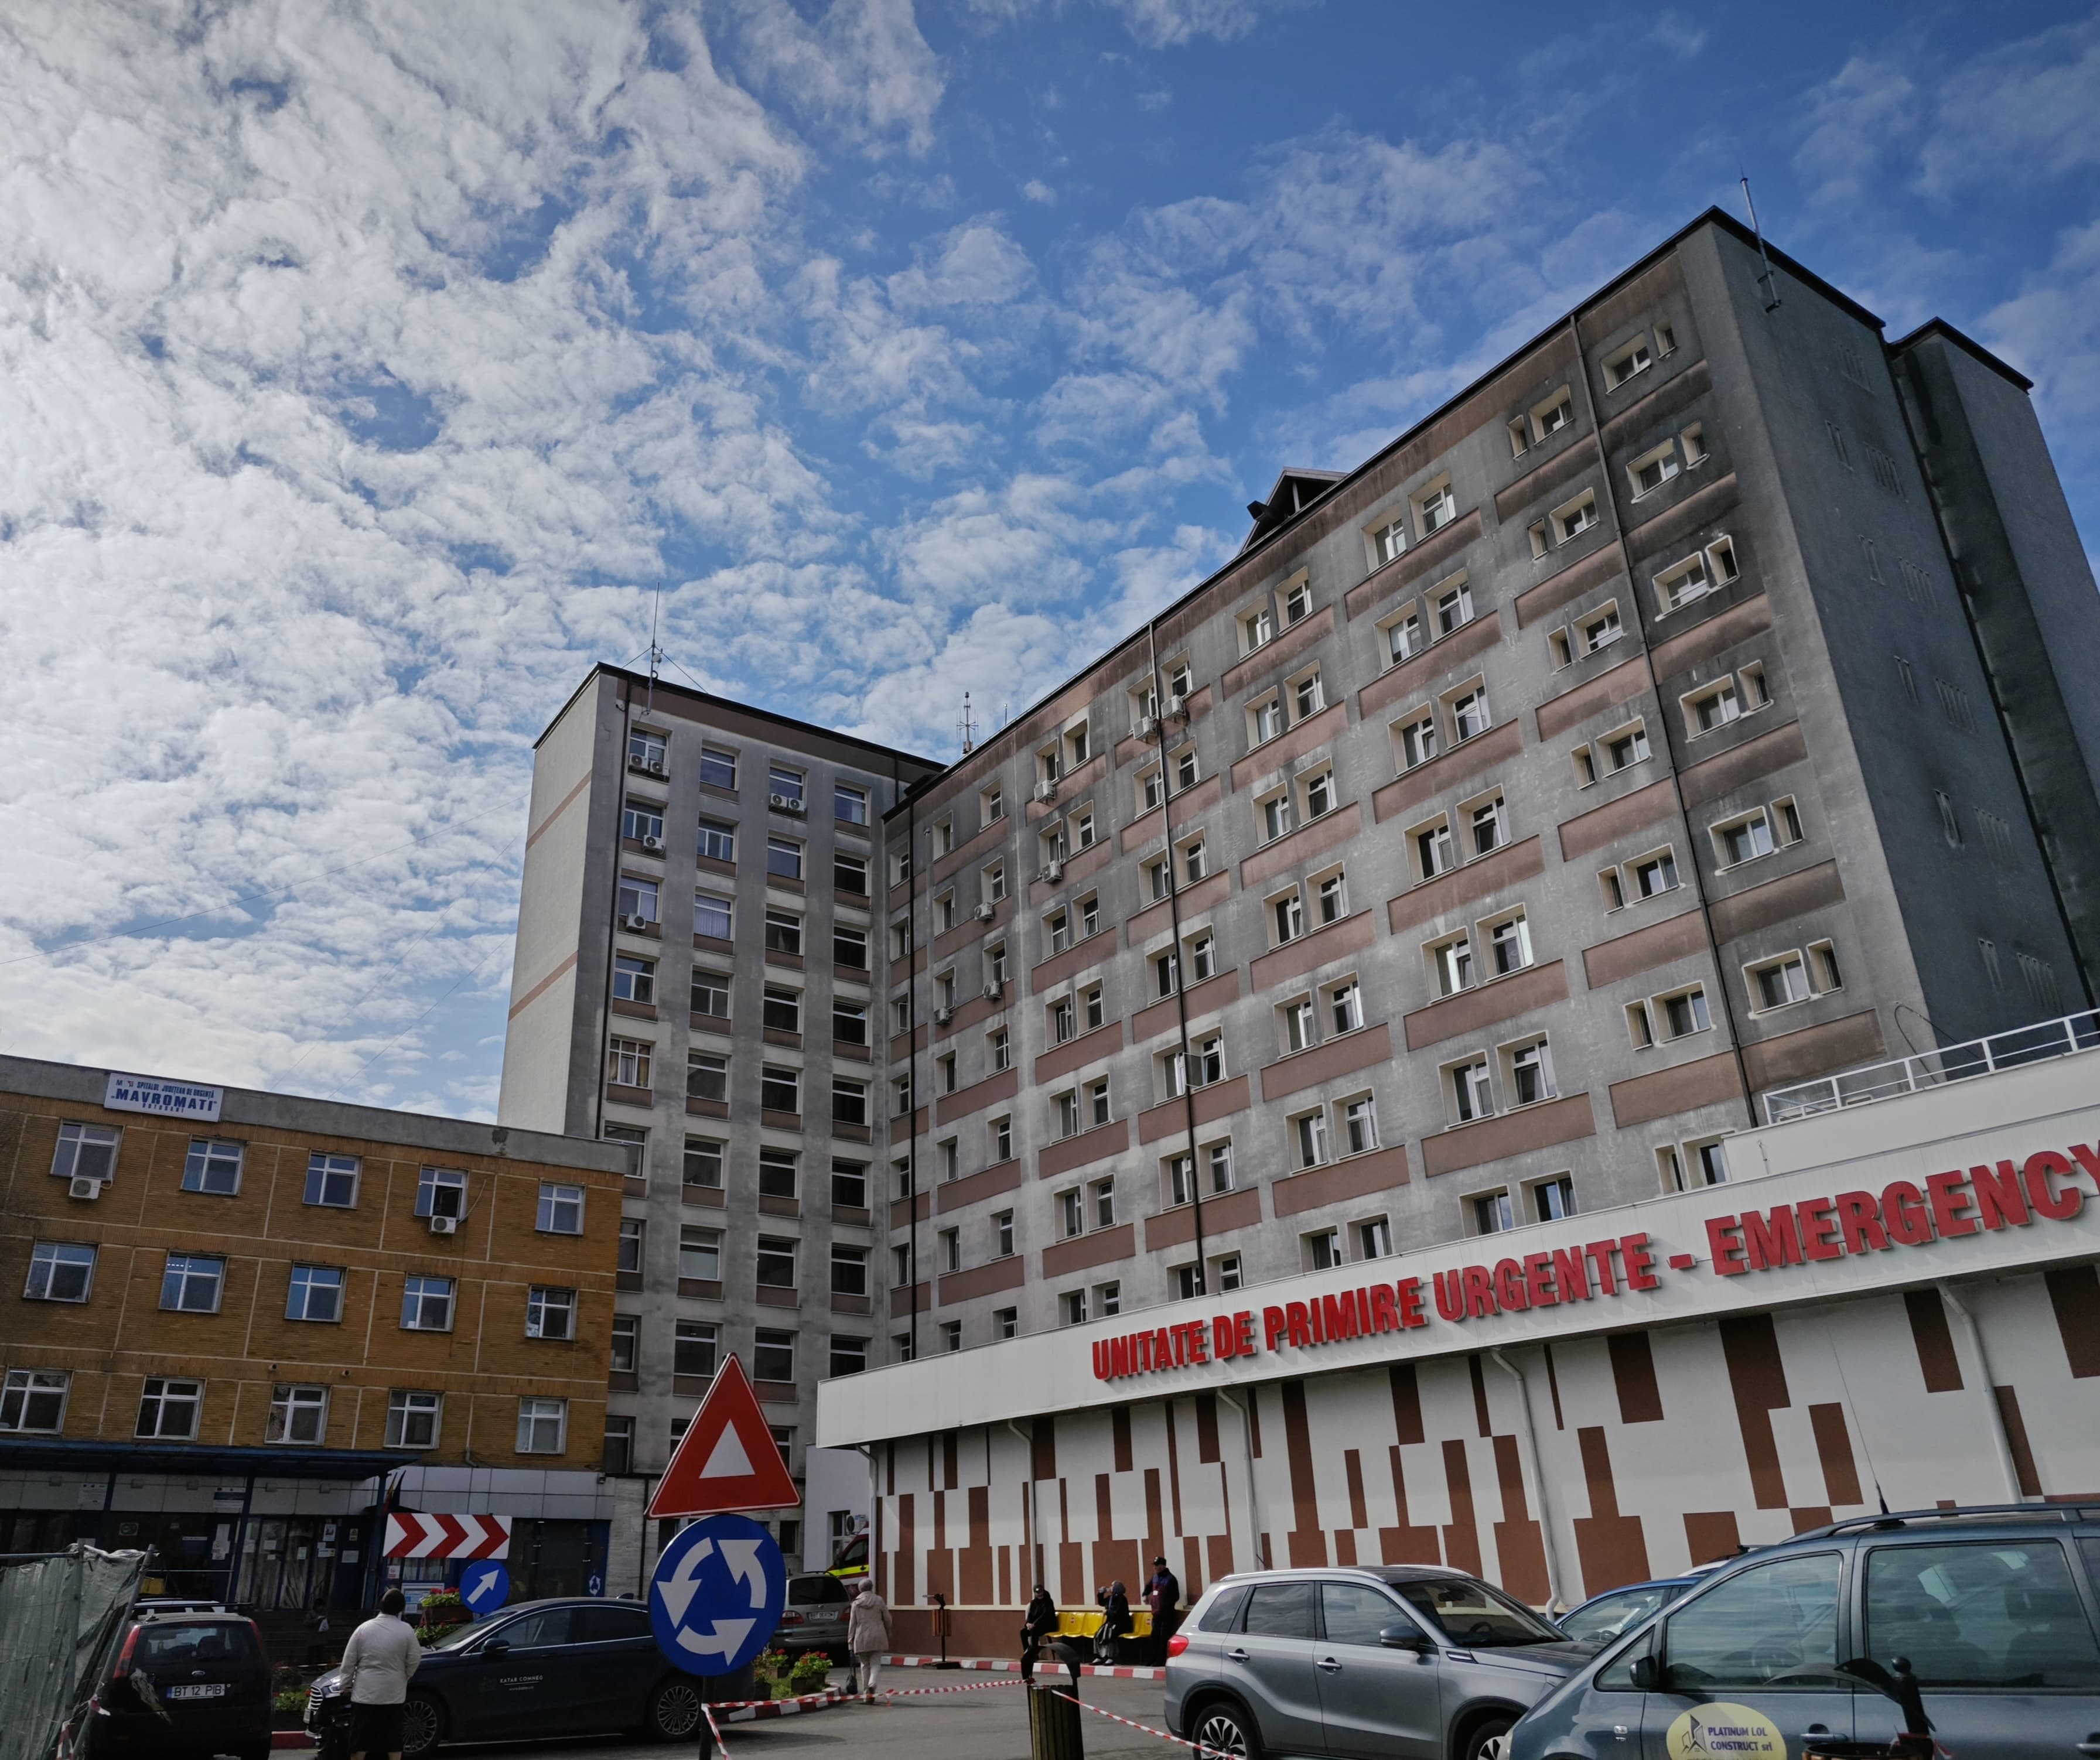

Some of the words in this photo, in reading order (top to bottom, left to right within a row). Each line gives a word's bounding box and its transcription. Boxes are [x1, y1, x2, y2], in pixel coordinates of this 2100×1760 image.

[136, 1081, 159, 1091] SPITALUL
[1092, 1319, 1209, 1380] UNITATE
[1213, 1310, 1256, 1359] DE
[1263, 1277, 1428, 1352] PRIMIRE
[1432, 1232, 1660, 1322] URGENTE
[174, 1687, 188, 1697] BT
[192, 1686, 200, 1696] 12
[205, 1685, 222, 1695] PIB
[1708, 1727, 1749, 1737] PLATINUM
[1752, 1727, 1768, 1737] LOL
[1710, 1741, 1758, 1751] CONSTRUCT
[1761, 1742, 1773, 1751] srl
